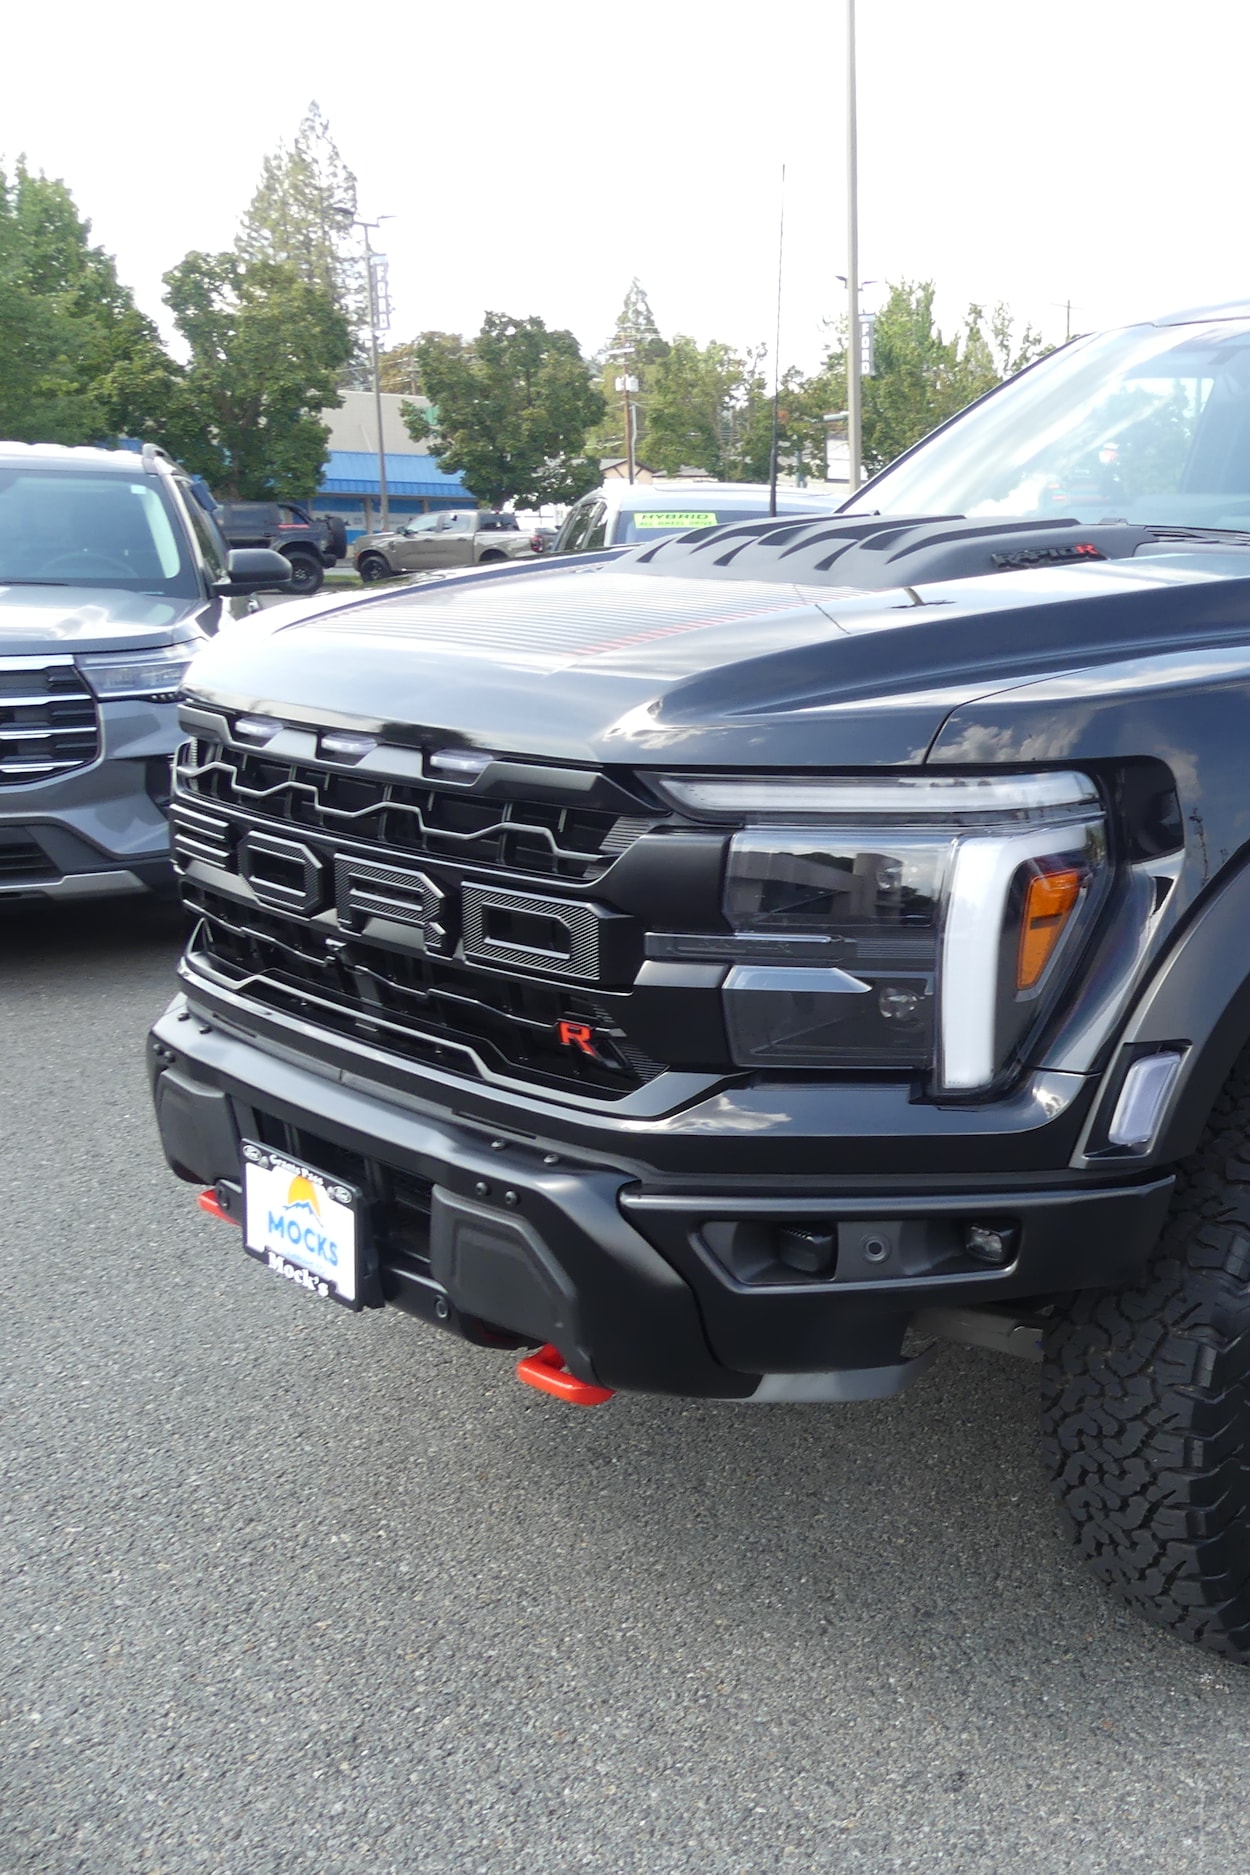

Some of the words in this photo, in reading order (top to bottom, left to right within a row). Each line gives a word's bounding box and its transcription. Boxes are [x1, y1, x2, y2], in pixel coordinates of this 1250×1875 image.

[991, 543, 1099, 570] RAPTOR
[170, 803, 604, 985] FORD
[559, 1021, 599, 1057] R
[269, 1211, 338, 1266] MOCKS
[268, 1252, 329, 1297] Mock's
